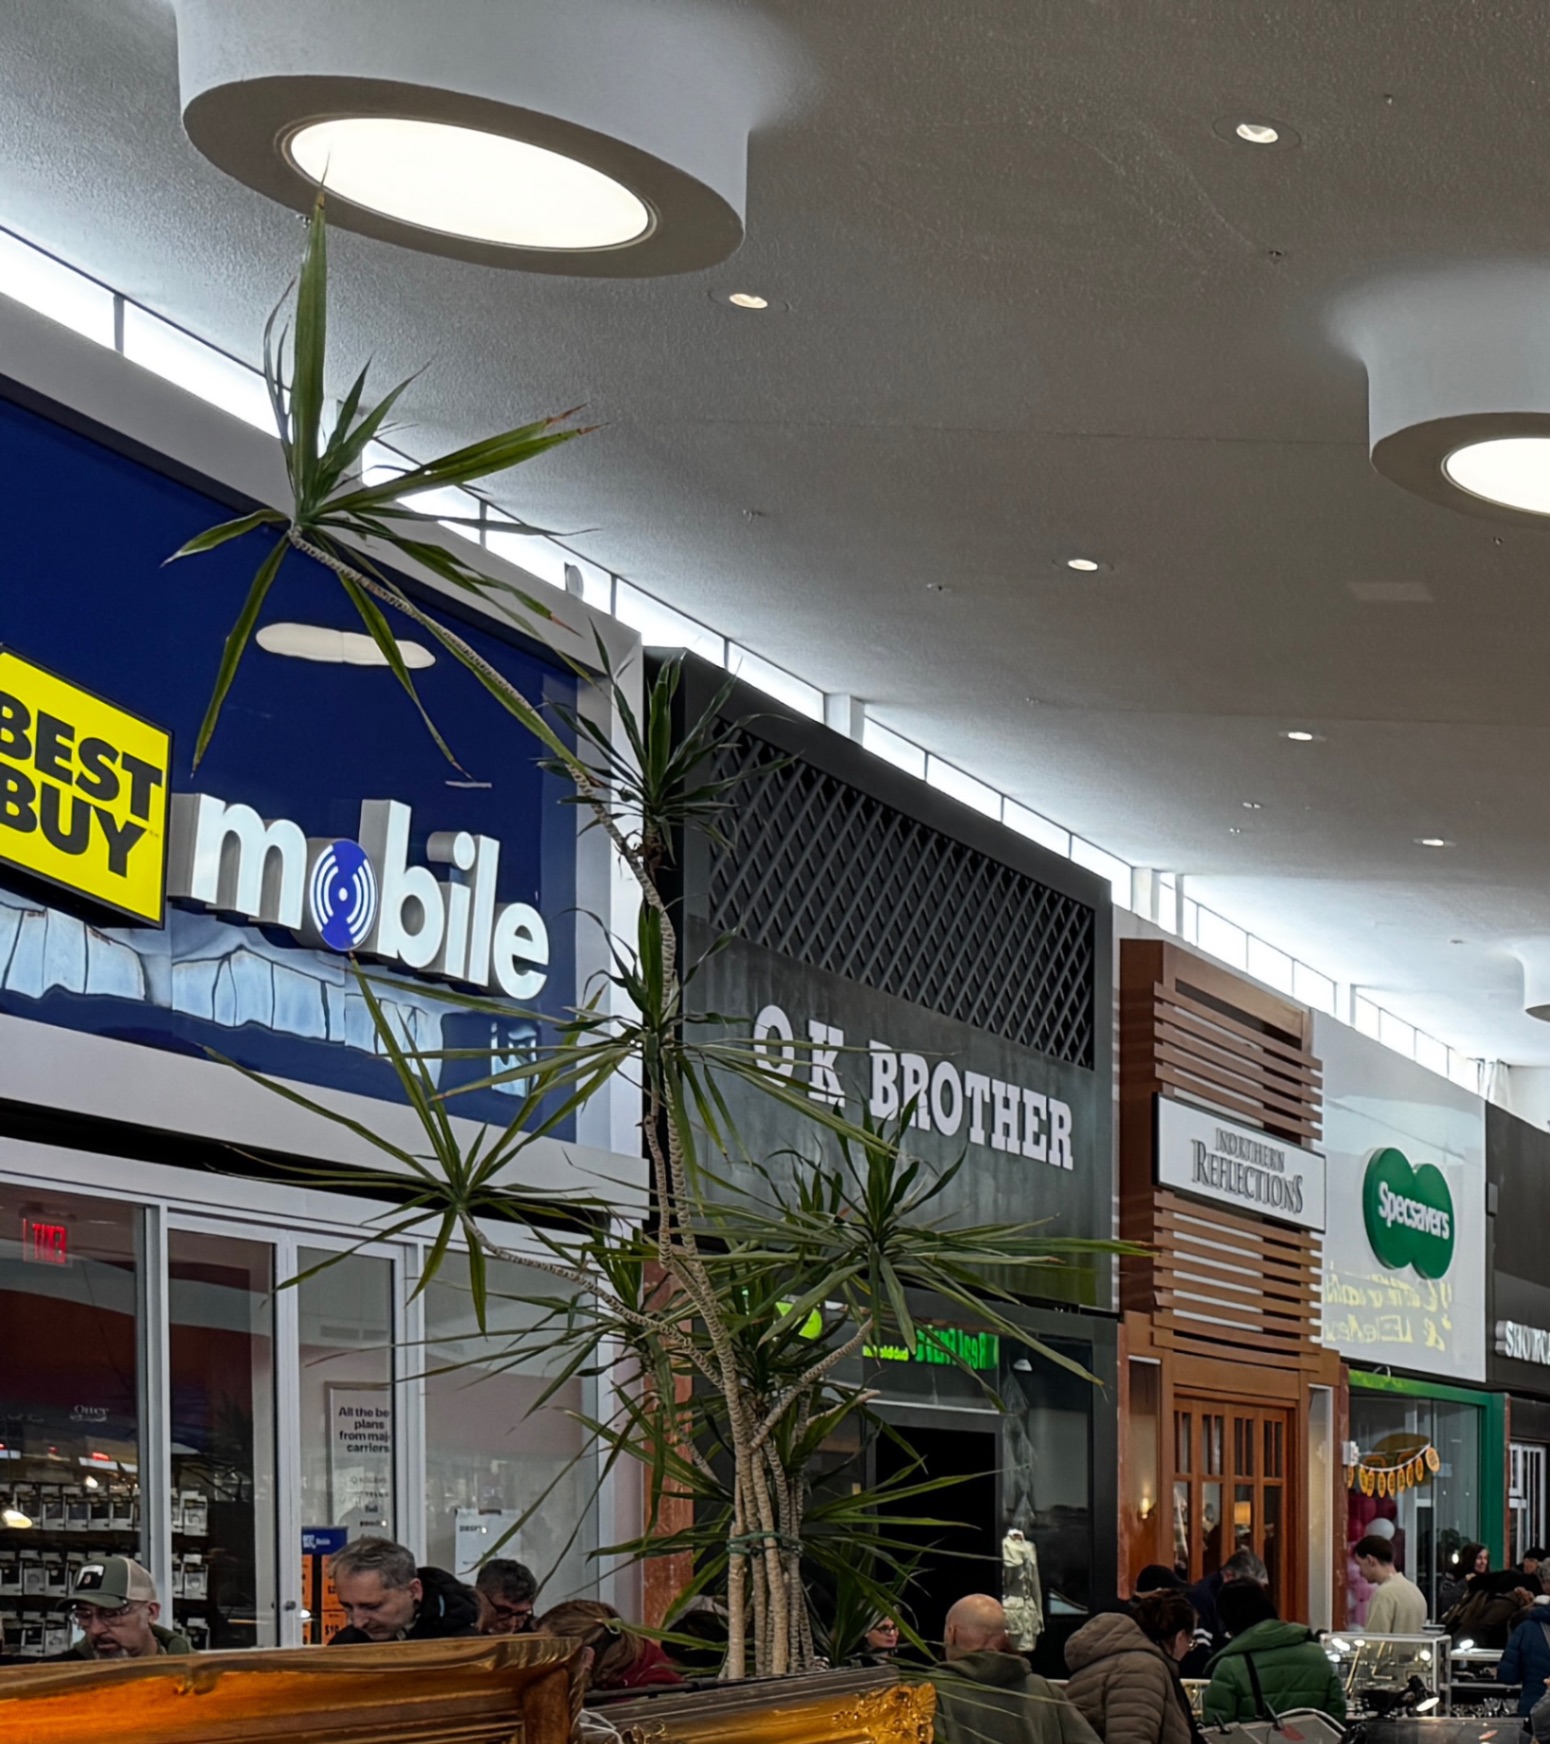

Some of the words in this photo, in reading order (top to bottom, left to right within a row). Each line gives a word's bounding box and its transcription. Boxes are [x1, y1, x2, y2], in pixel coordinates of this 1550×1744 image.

[0, 690, 164, 822] BEST
[0, 761, 148, 879] BUY
[178, 793, 549, 1000] mobile
[869, 1039, 1074, 1171] BROTHER
[1190, 1139, 1303, 1214] REFLECTIONS
[1215, 1127, 1285, 1173] NORTHERN
[1378, 1181, 1450, 1240] Specsavers
[338, 1406, 353, 1418] All
[355, 1406, 373, 1418] the
[375, 1406, 390, 1418] be
[339, 1431, 366, 1441] from
[367, 1431, 390, 1443] maj
[354, 1418, 384, 1430] plans
[346, 1443, 390, 1453] carriers
